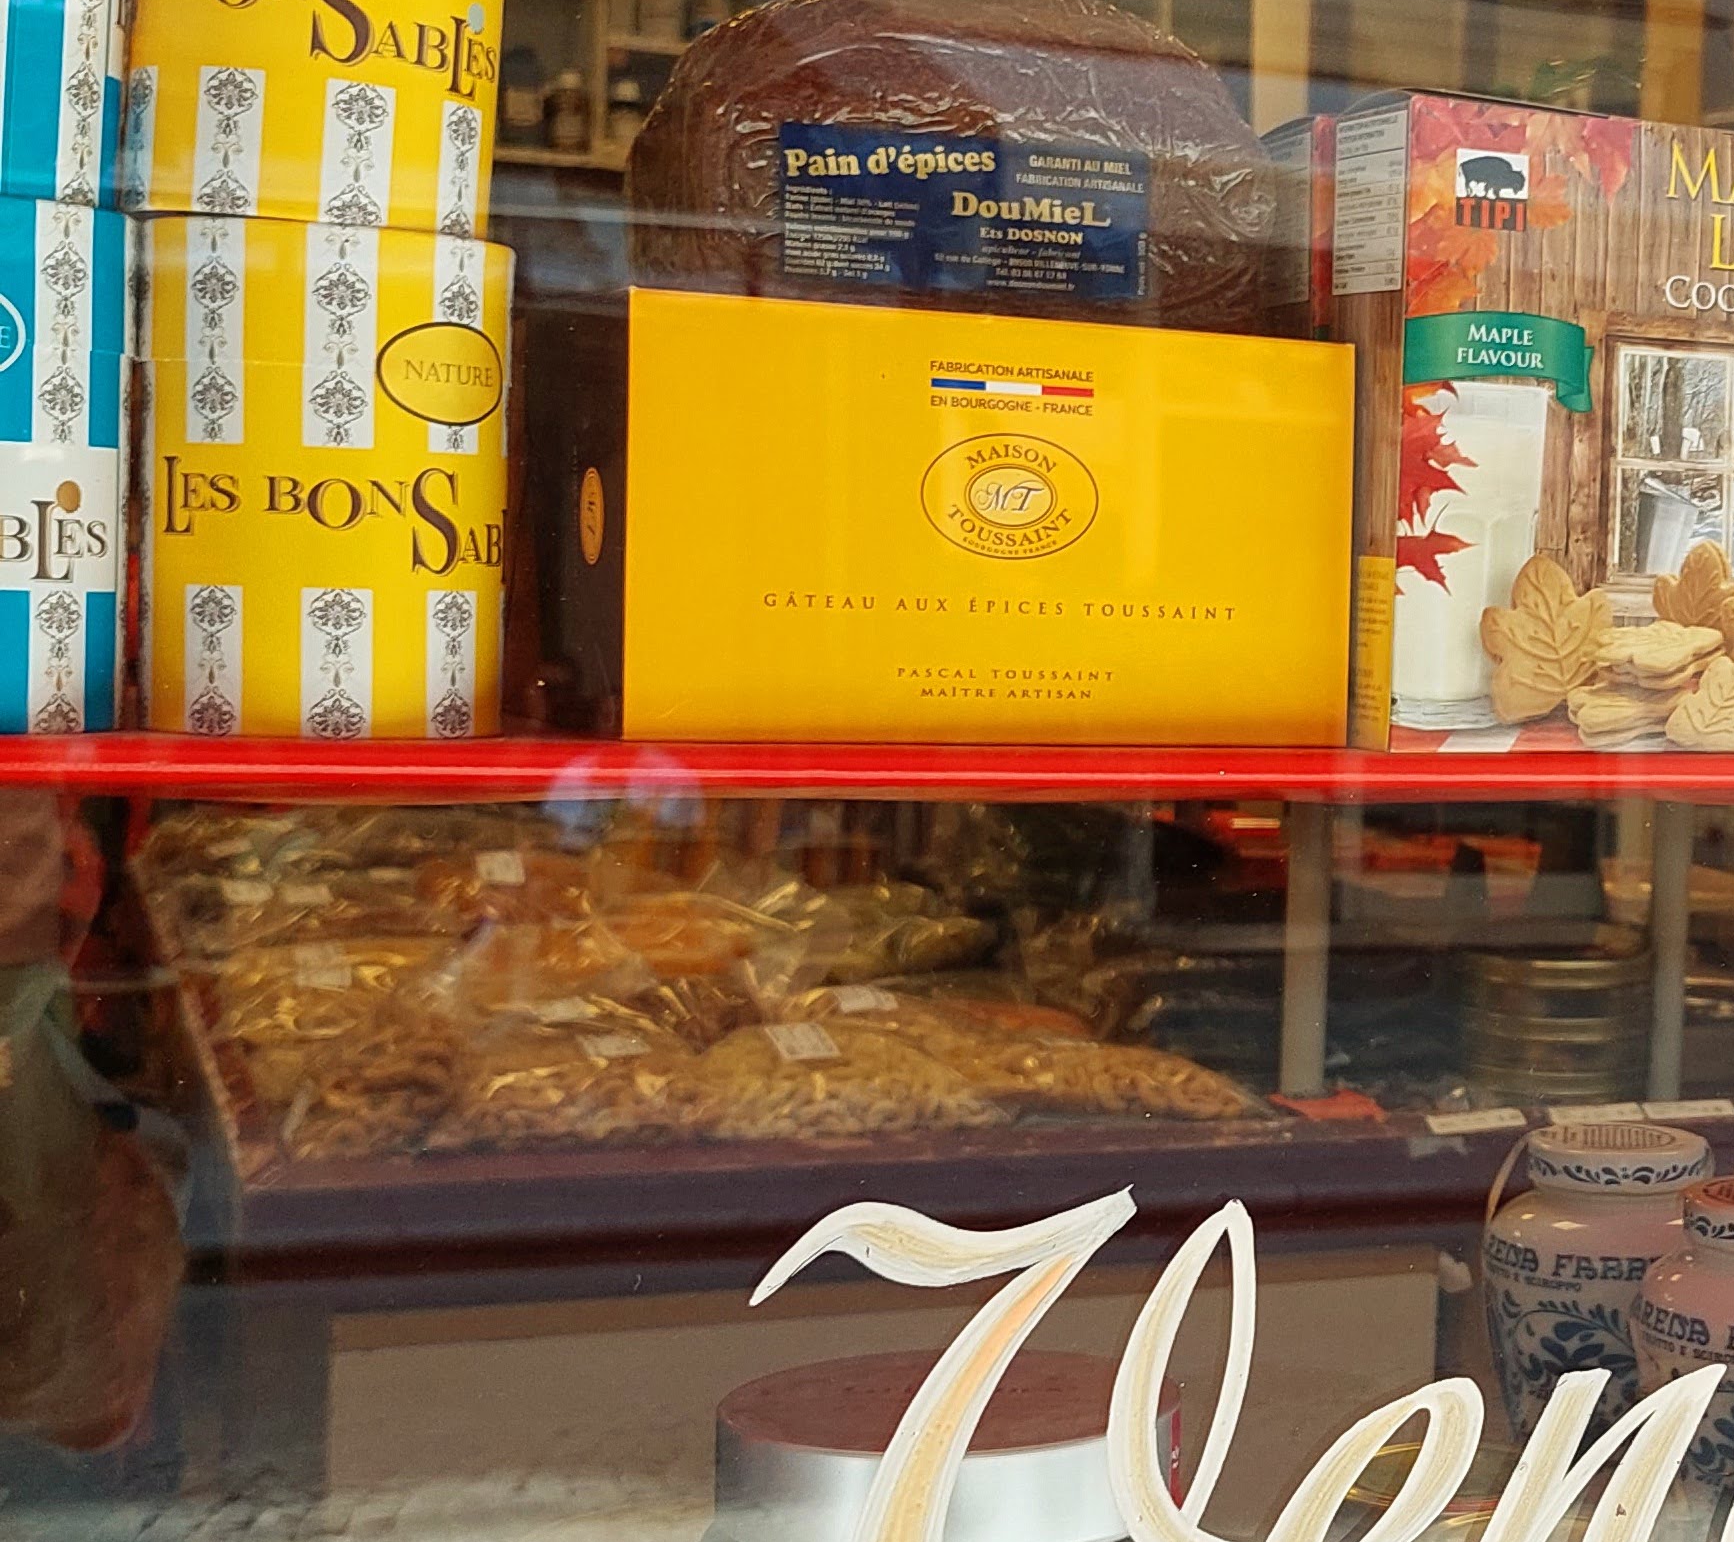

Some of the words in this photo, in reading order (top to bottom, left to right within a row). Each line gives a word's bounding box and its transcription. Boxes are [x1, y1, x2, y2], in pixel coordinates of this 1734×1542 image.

[783, 146, 859, 177] Pain
[866, 143, 996, 180] d'épices
[1028, 154, 1081, 171] GARANTI
[1083, 158, 1101, 173] AU
[1103, 159, 1133, 176] MIEL
[1015, 173, 1081, 188] FABRICATION
[1083, 179, 1145, 194] ARTISANALE
[1459, 198, 1527, 231] TIPI
[1006, 228, 1084, 246] DOSNON
[1468, 322, 1534, 347] MAPLE
[1456, 345, 1545, 370] FLAVOUR
[402, 357, 495, 390] NATURE
[930, 360, 1014, 376] FABRICATION
[1017, 369, 1094, 382] ARTISANALE
[930, 395, 947, 407] EN
[951, 396, 1032, 412] BOURGOGNE
[1043, 402, 1093, 416] FRANCE
[964, 444, 1057, 474] MAISON
[162, 455, 242, 536] LES
[948, 504, 1073, 547] TOUSSAINT
[763, 590, 876, 610] GÂTEAU
[895, 597, 949, 613] AUX
[968, 597, 1065, 617] ÉPICES
[1083, 602, 1237, 621] TOUSSAINT
[897, 667, 978, 680] PASCAL
[991, 668, 1115, 681] TOUSSAINT
[920, 685, 997, 700] MAÎTRE
[1006, 687, 1093, 700] ARTISAN
